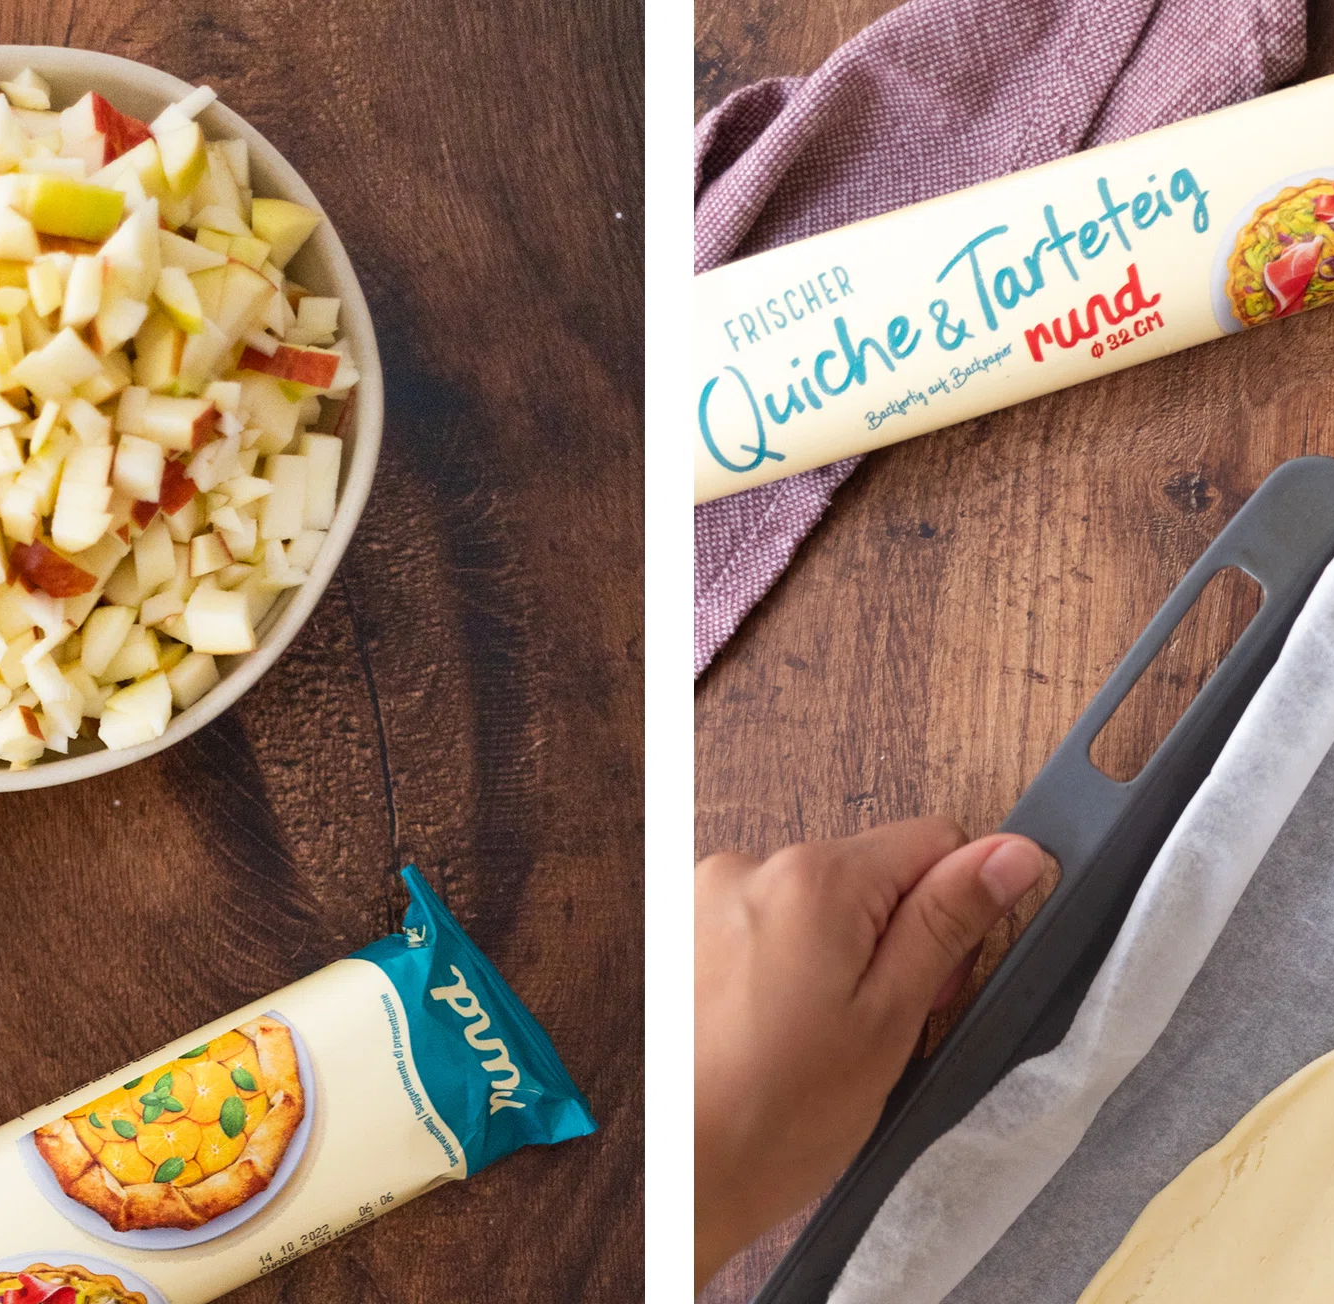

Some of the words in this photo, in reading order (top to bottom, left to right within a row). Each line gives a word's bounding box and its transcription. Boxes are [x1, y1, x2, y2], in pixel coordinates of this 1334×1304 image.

[936, 167, 1211, 331] Tarteteig
[723, 264, 855, 352] FRISCHER
[928, 298, 975, 351] &
[1024, 262, 1161, 363] rund
[1106, 328, 1134, 351] 32
[1133, 310, 1165, 338] CM
[698, 312, 922, 474] Quiche
[865, 389, 929, 430] Backfertig
[928, 376, 951, 393] auf
[949, 342, 1013, 389] Backpapier
[380, 993, 404, 1049] presentazione
[430, 964, 526, 1115] rund
[393, 1050, 404, 1059] di
[396, 1060, 425, 1115] Suggerimento
[423, 1115, 460, 1168] Serviervorschlag
[258, 1252, 273, 1266] 14
[280, 1241, 295, 1255] 10
[300, 1223, 331, 1246] 2022
